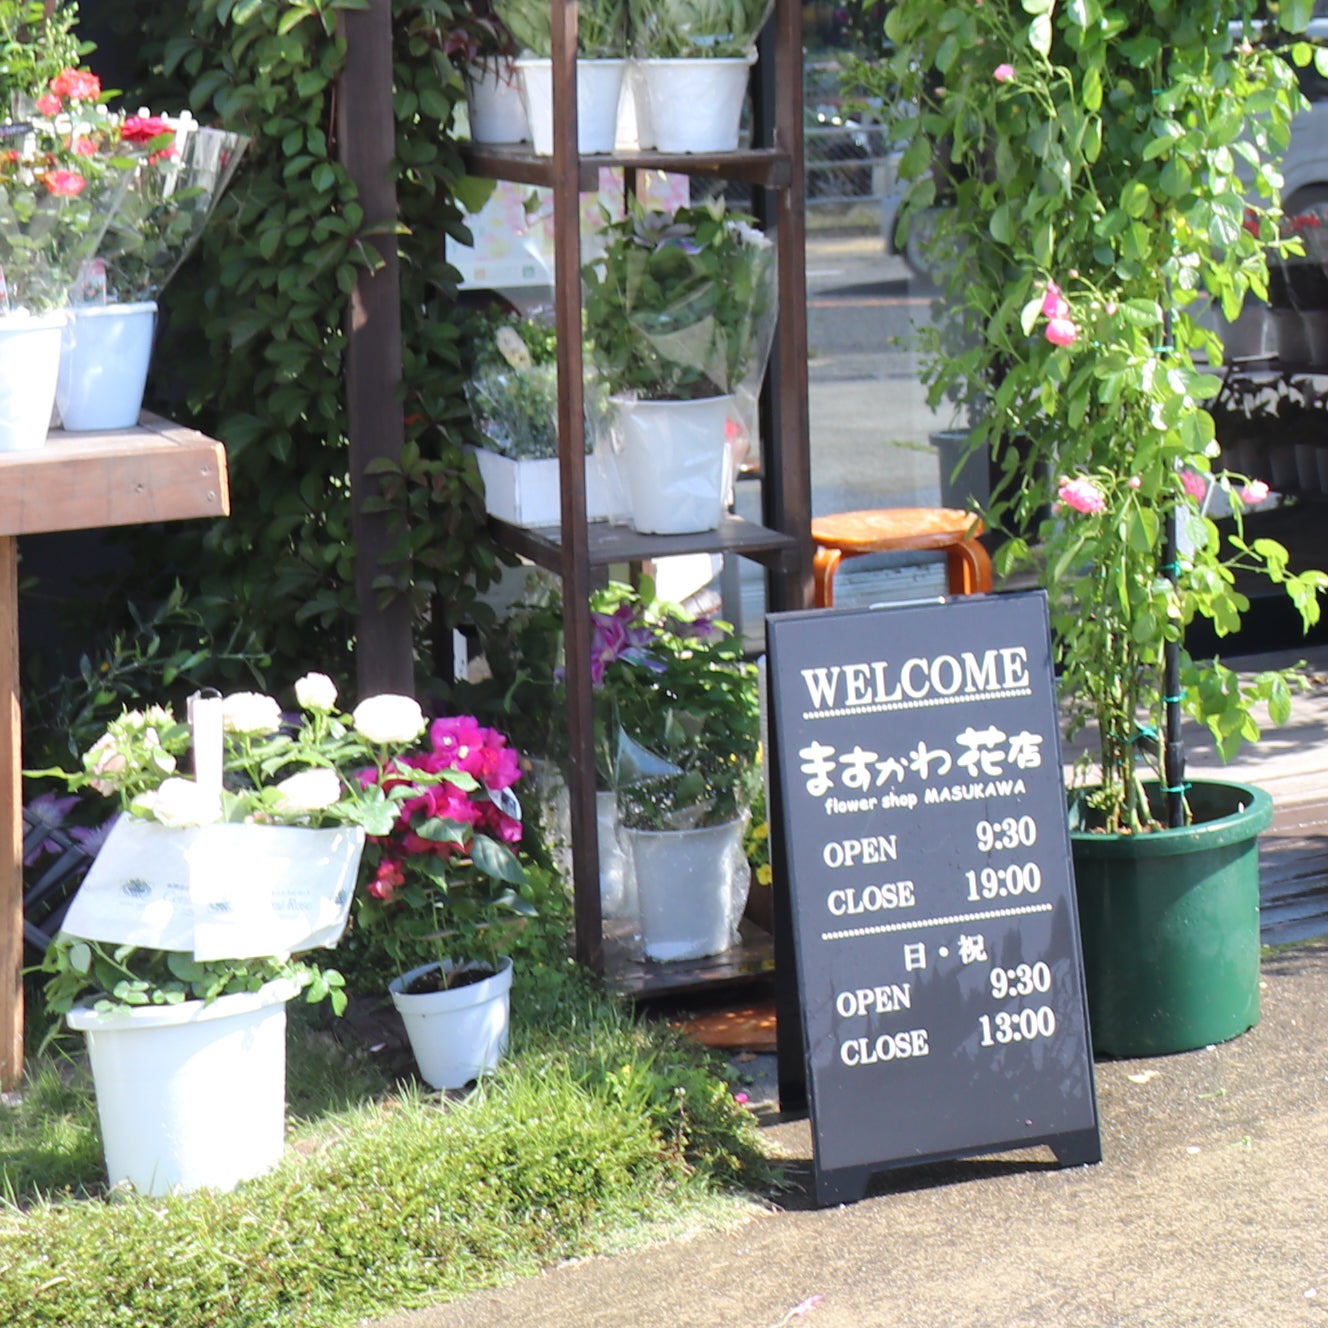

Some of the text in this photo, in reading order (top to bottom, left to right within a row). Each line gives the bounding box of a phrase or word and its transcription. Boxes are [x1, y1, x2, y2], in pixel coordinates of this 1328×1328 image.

[801, 646, 1030, 710] WELCOME
[824, 778, 1027, 816] flower shop MASUKAWA
[823, 814, 1037, 869] OPEN 9:30
[827, 861, 1042, 917] CLOSE 19:00
[836, 961, 1052, 1018] OPEN 9:30
[840, 1005, 1057, 1066] CLOSE 13:00
